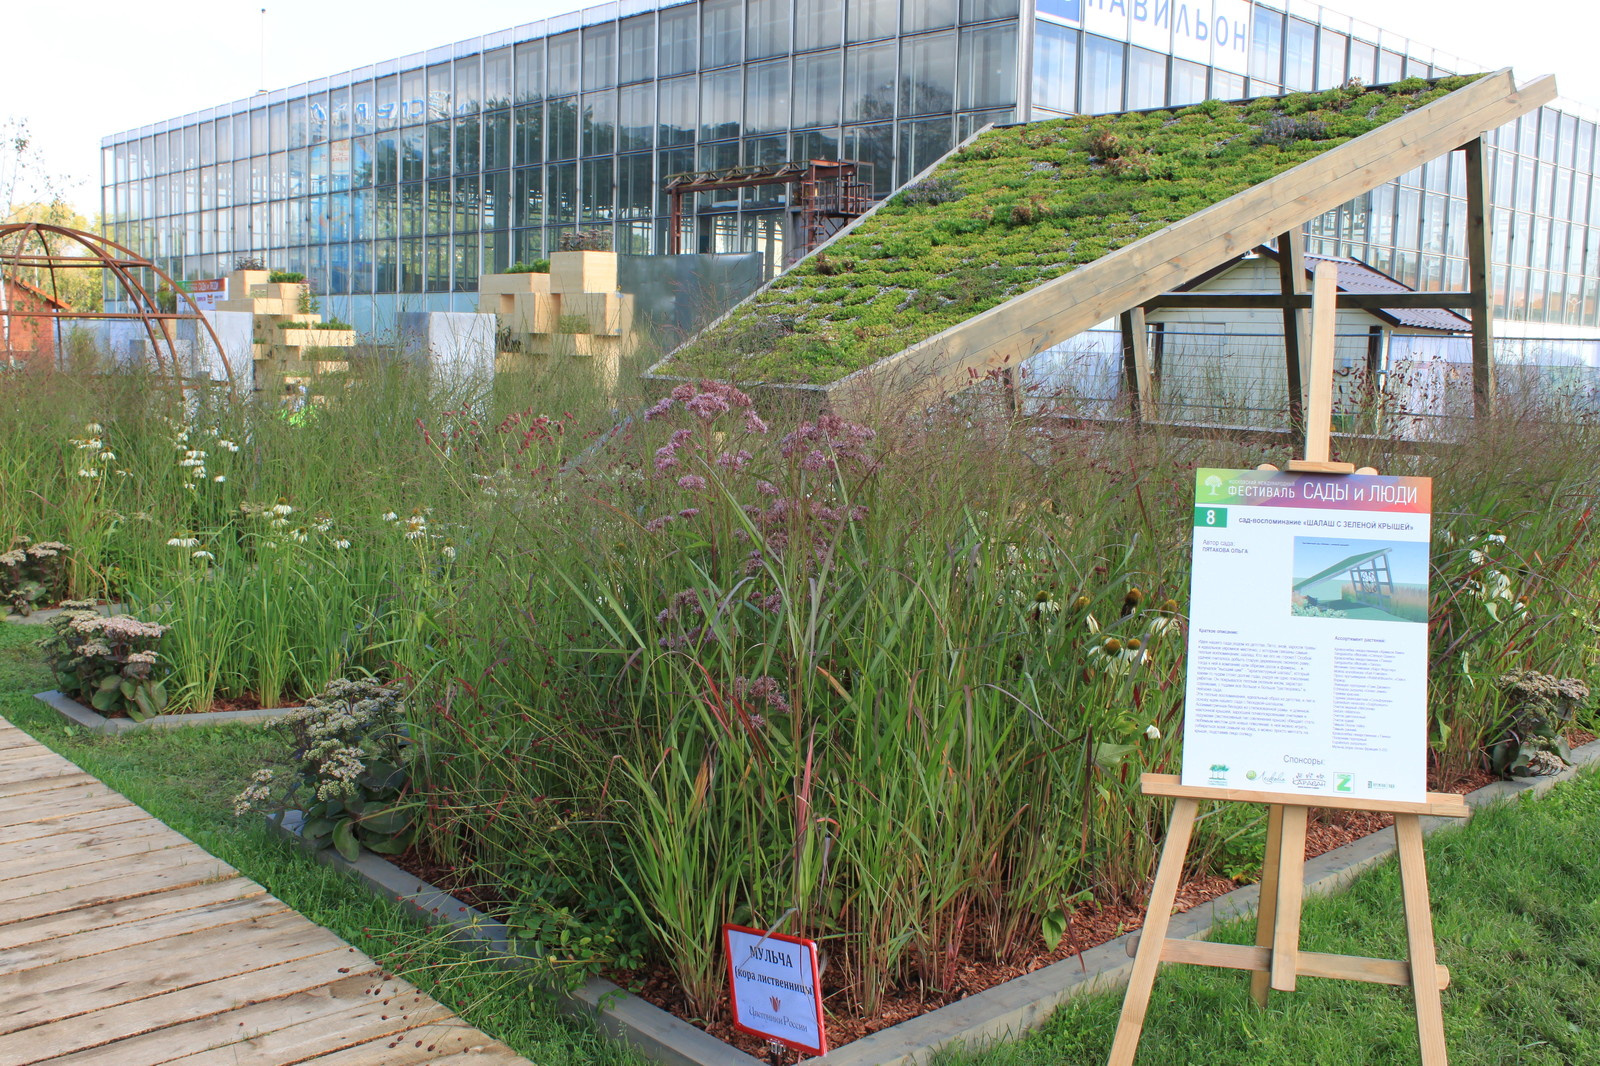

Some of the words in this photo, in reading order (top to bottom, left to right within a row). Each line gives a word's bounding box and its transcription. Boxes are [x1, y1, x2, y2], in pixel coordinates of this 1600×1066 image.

[1088, 0, 1246, 53] АВИЛЬОН
[1228, 485, 1295, 499] ФЕСТИВАЛЬ
[1303, 482, 1349, 502] САДЫ
[1368, 484, 1417, 505] ЛЮДИ
[1206, 509, 1216, 525] 8
[1336, 520, 1342, 528] С
[1343, 520, 1376, 529] ЗЕЛЕНОЙ
[749, 945, 793, 968] МУЛЬЧА
[734, 965, 756, 982] (кора
[783, 1015, 808, 1032] России
